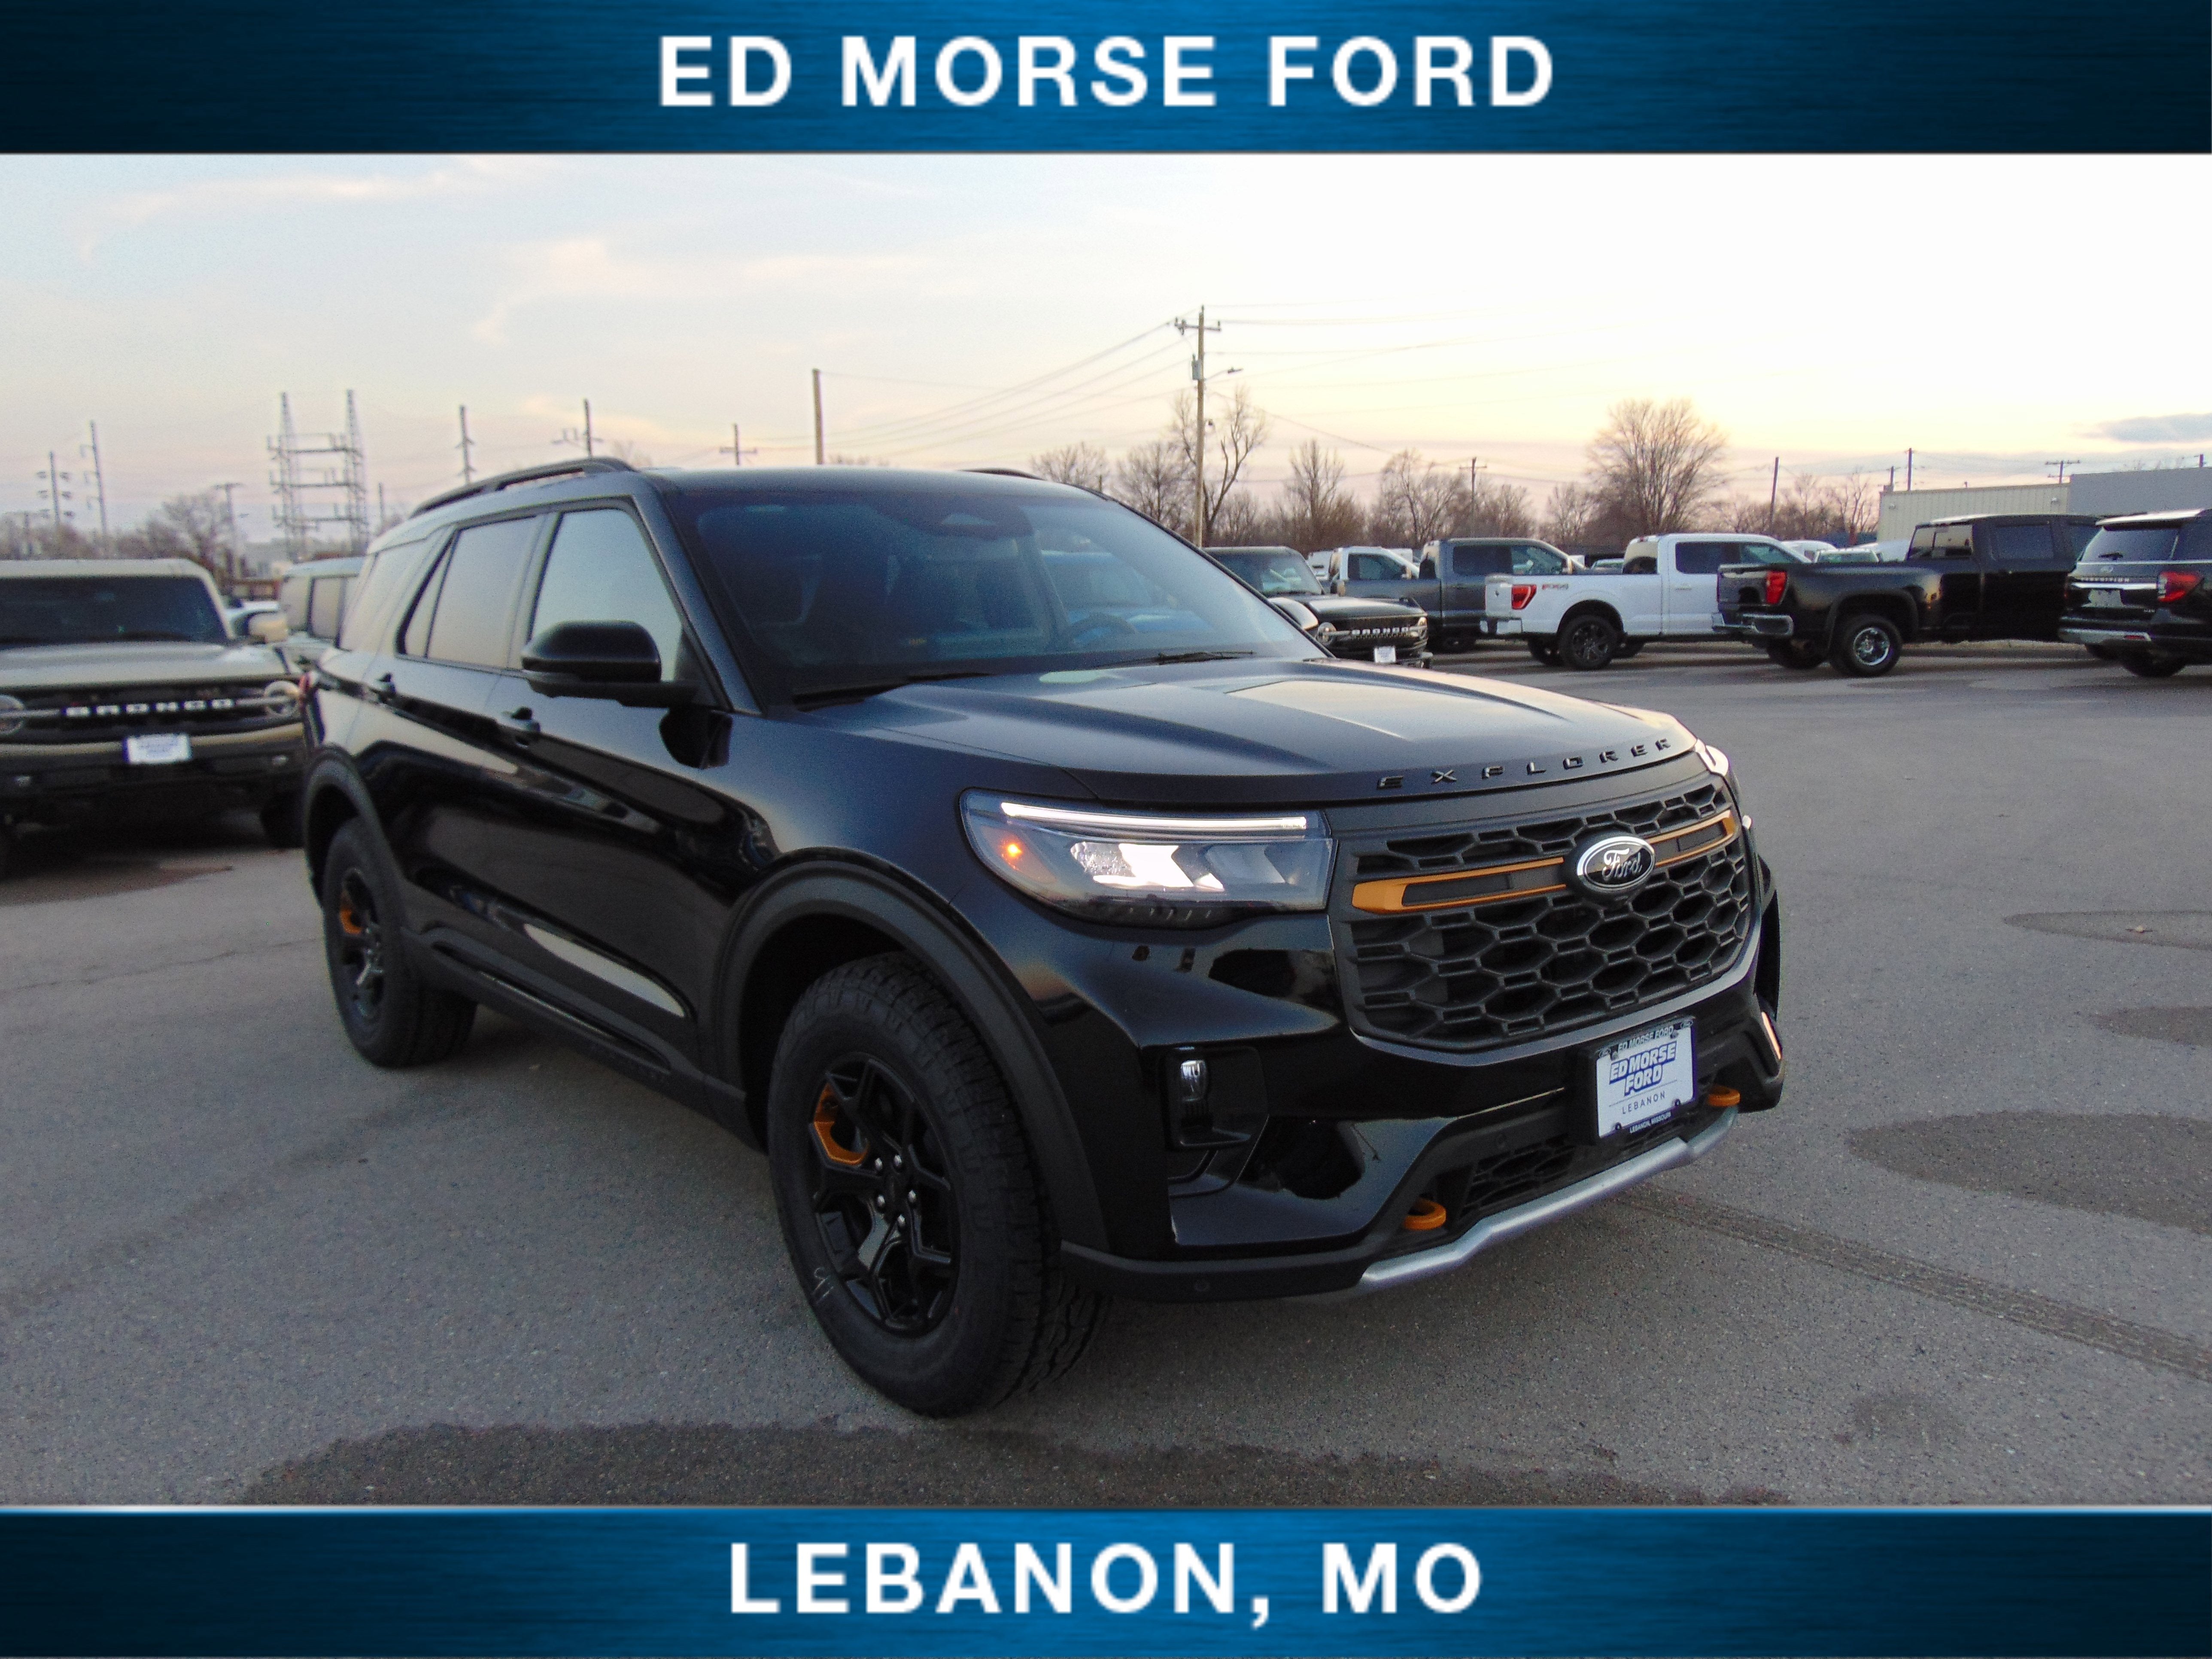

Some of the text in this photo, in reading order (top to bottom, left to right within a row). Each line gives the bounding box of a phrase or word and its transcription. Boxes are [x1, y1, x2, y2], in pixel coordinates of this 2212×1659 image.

[65, 698, 234, 718] BRONCO
[1377, 738, 1671, 790] EXPLORER
[1602, 848, 1643, 882] Ford
[1617, 1042, 1628, 1053] ED
[1629, 1032, 1654, 1048] MORSE
[1654, 1025, 1674, 1039] FORD
[1610, 1042, 1676, 1084] ED MORSE
[1625, 1064, 1662, 1096] FORD
[1622, 1091, 1665, 1115] LEBANON
